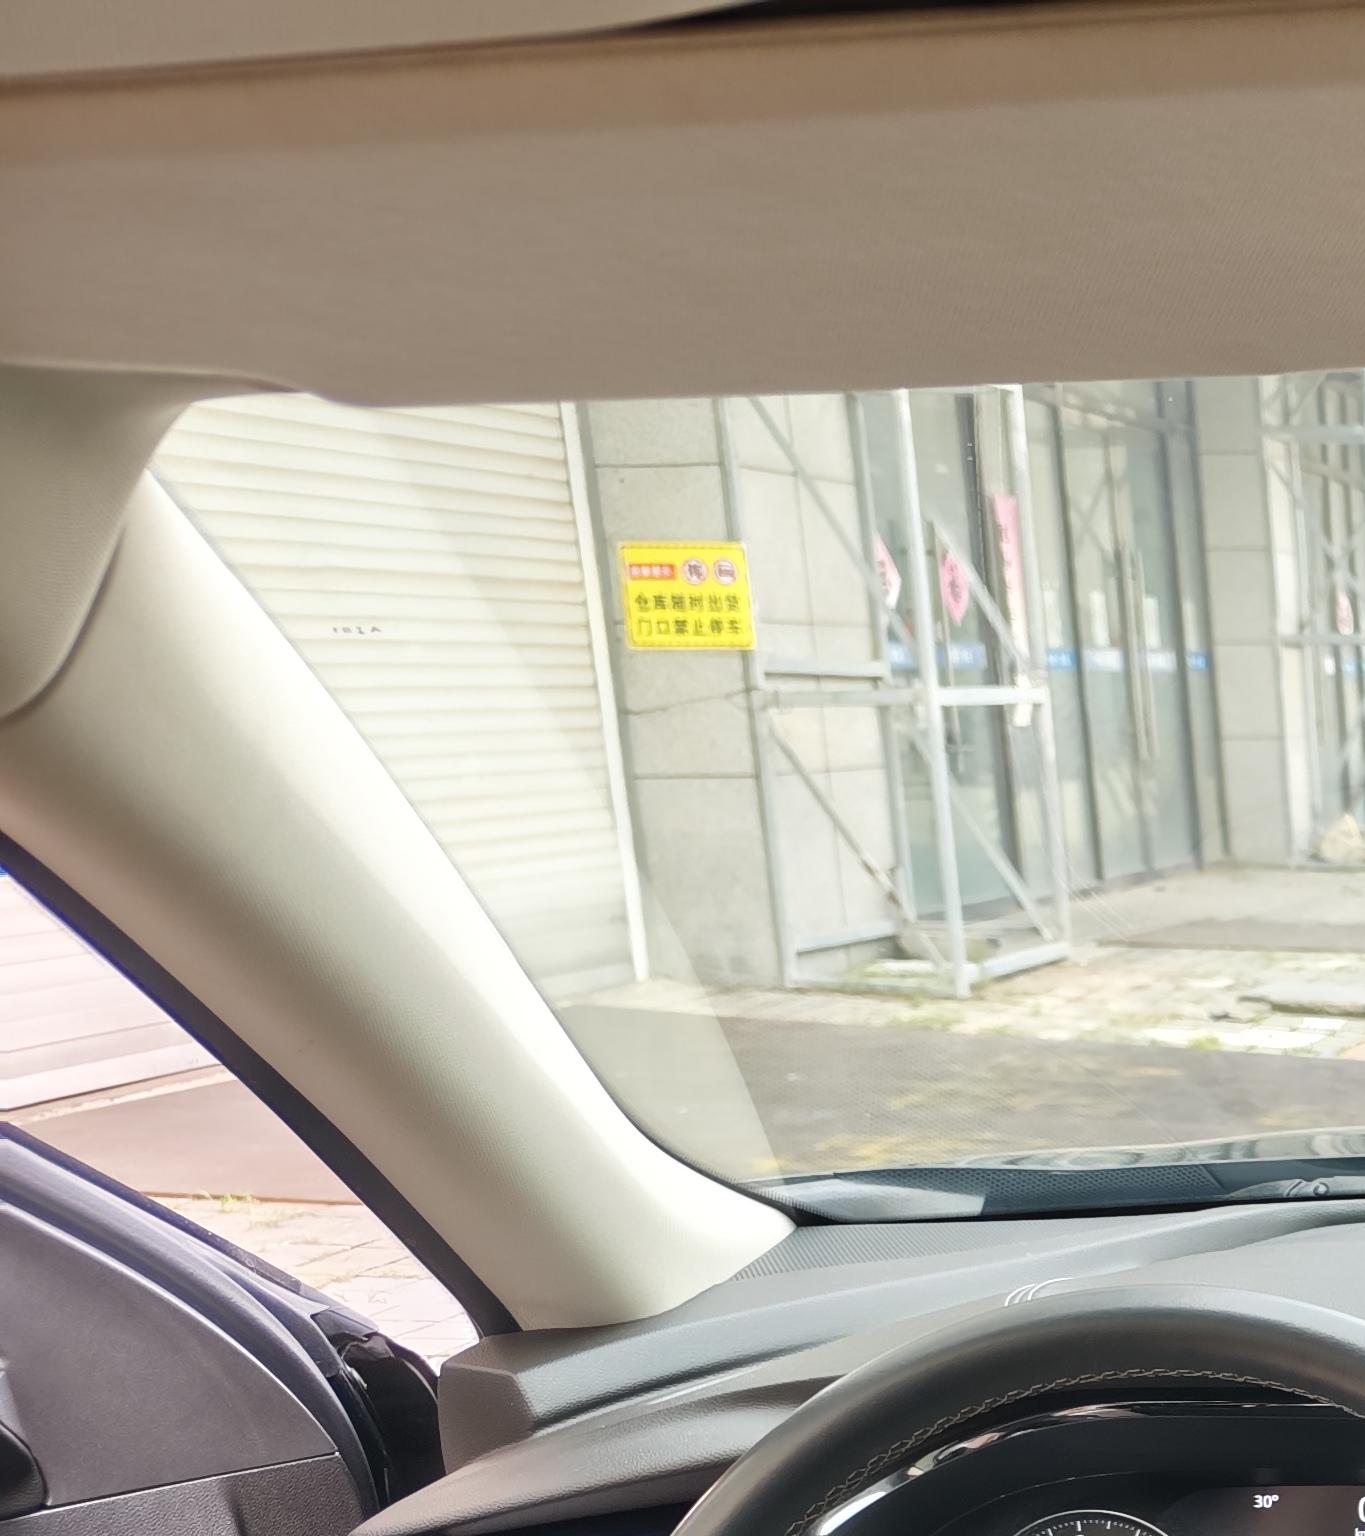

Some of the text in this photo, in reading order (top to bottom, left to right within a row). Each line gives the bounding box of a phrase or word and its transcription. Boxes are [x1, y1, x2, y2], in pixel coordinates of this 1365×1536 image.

[637, 618, 742, 637] 门口禁止停车
